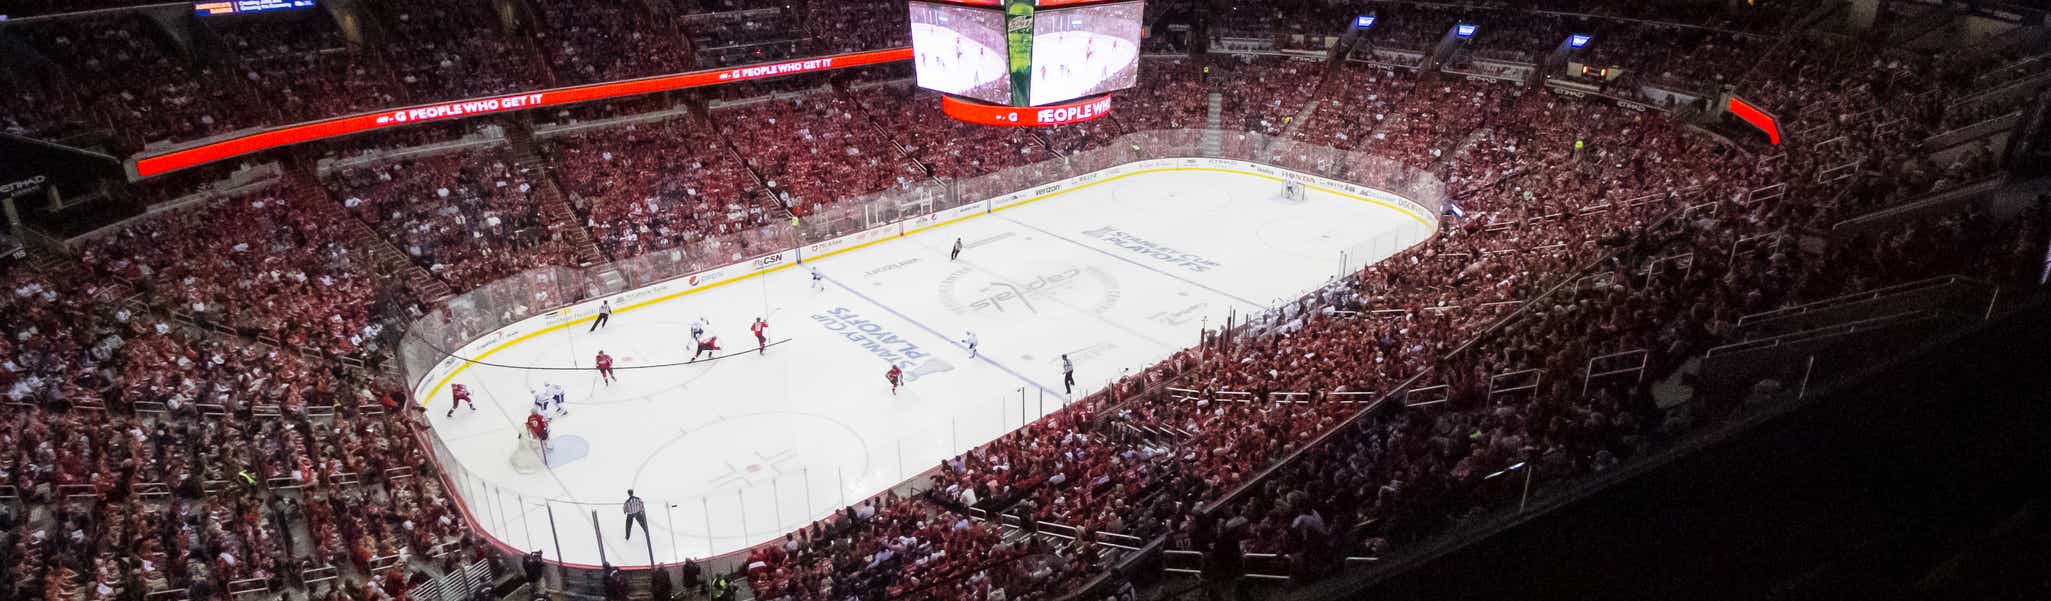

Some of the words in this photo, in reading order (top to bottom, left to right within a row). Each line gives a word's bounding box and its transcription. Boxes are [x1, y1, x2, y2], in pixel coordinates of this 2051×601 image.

[732, 70, 740, 79] G
[743, 65, 777, 77] PEOPLE
[777, 62, 802, 73] WHO
[804, 60, 821, 70] GET
[822, 58, 832, 67] IT
[394, 111, 406, 122] G
[409, 104, 462, 121] PEOPLE
[463, 99, 498, 113] WHO
[501, 95, 528, 108] GET
[530, 93, 543, 105] IT
[1008, 112, 1018, 122] G
[1037, 107, 1092, 123] PEOPLE
[1035, 184, 1062, 196] verizon
[763, 254, 783, 265] CSN
[811, 314, 848, 331] CUP
[827, 307, 931, 359] PLAYOFFS
[840, 331, 918, 369] STANLEY
